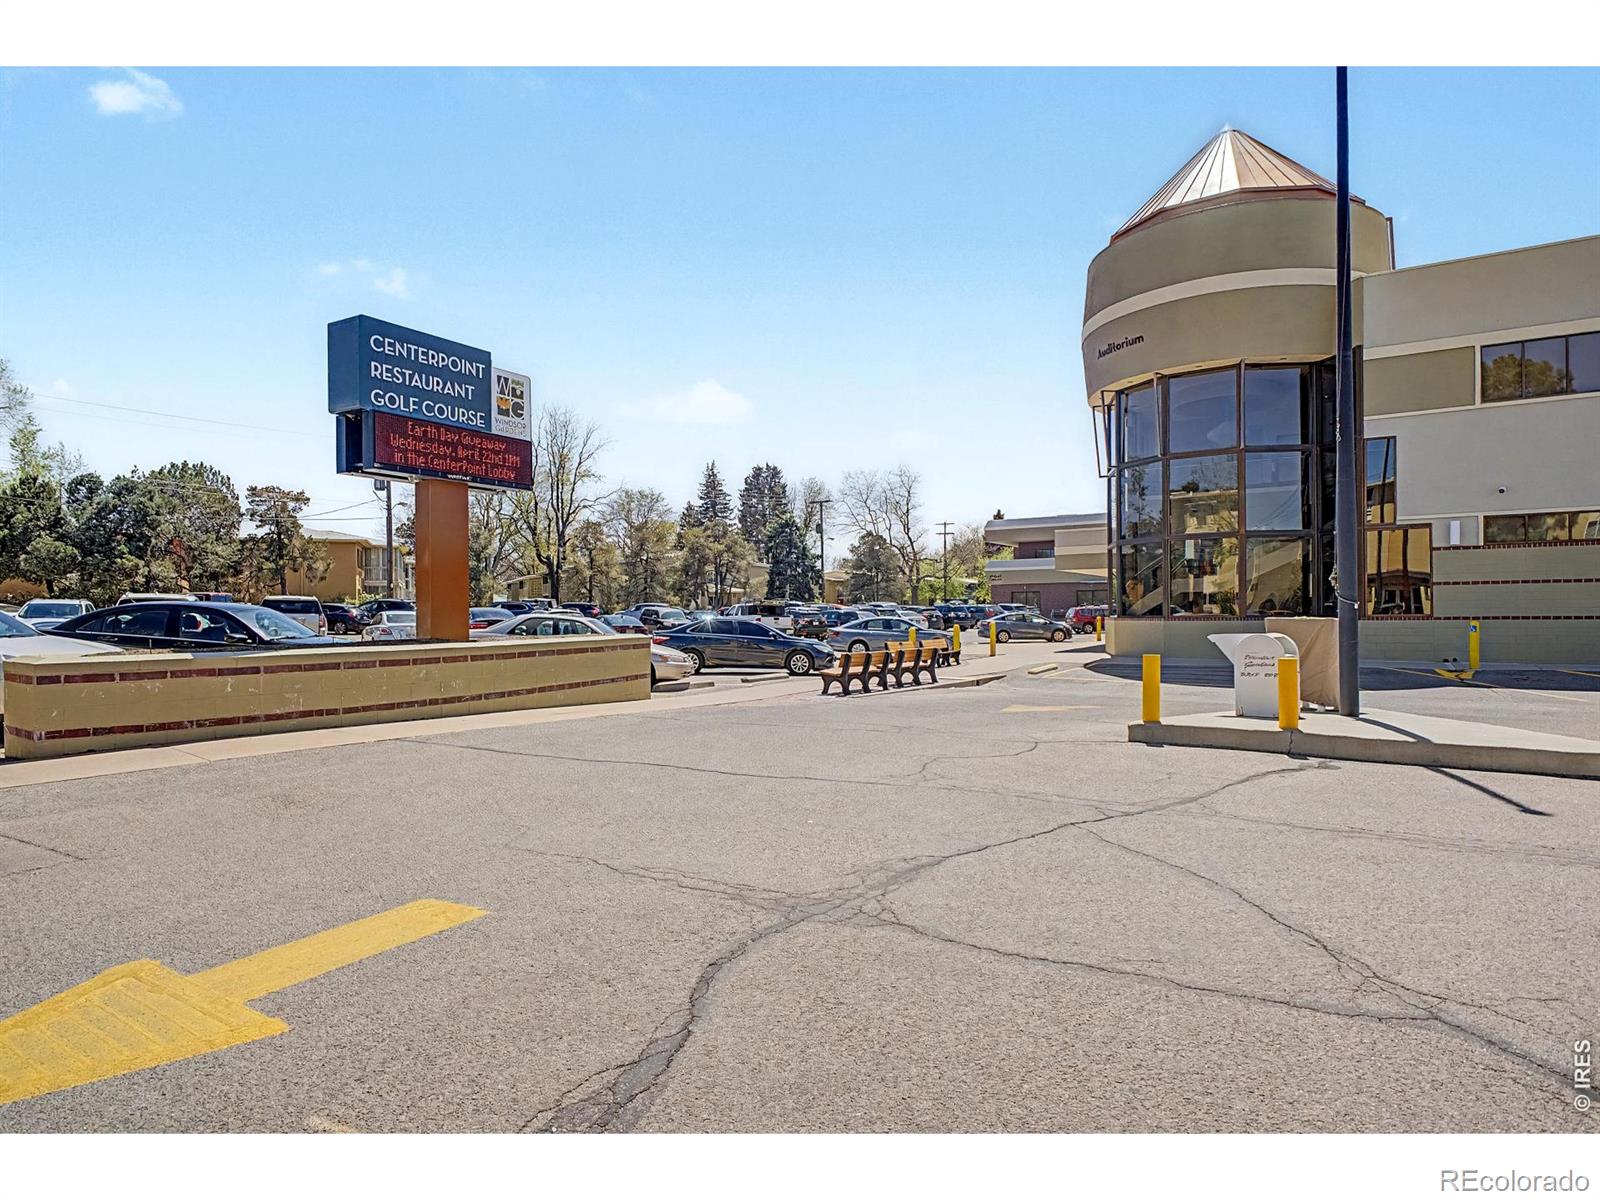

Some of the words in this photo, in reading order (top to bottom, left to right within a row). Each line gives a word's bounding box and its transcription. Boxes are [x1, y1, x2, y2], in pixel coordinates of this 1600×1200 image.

[369, 334, 486, 379] CENTERPOINT
[1097, 335, 1145, 360] Auditorium
[370, 361, 475, 400] RESTAURANT
[370, 389, 419, 413] GOLF
[422, 400, 486, 428] COURSE
[495, 417, 527, 430] WINDSOR
[407, 421, 438, 439] Earth
[440, 427, 459, 443] Day
[461, 431, 507, 452] Giveaway
[393, 448, 405, 463] in
[407, 451, 426, 467] the
[427, 454, 486, 477] CenterPoint
[487, 464, 516, 480] Lobby
[457, 445, 480, 461] April
[482, 450, 503, 465] 22nd
[505, 453, 520, 468] 1PM
